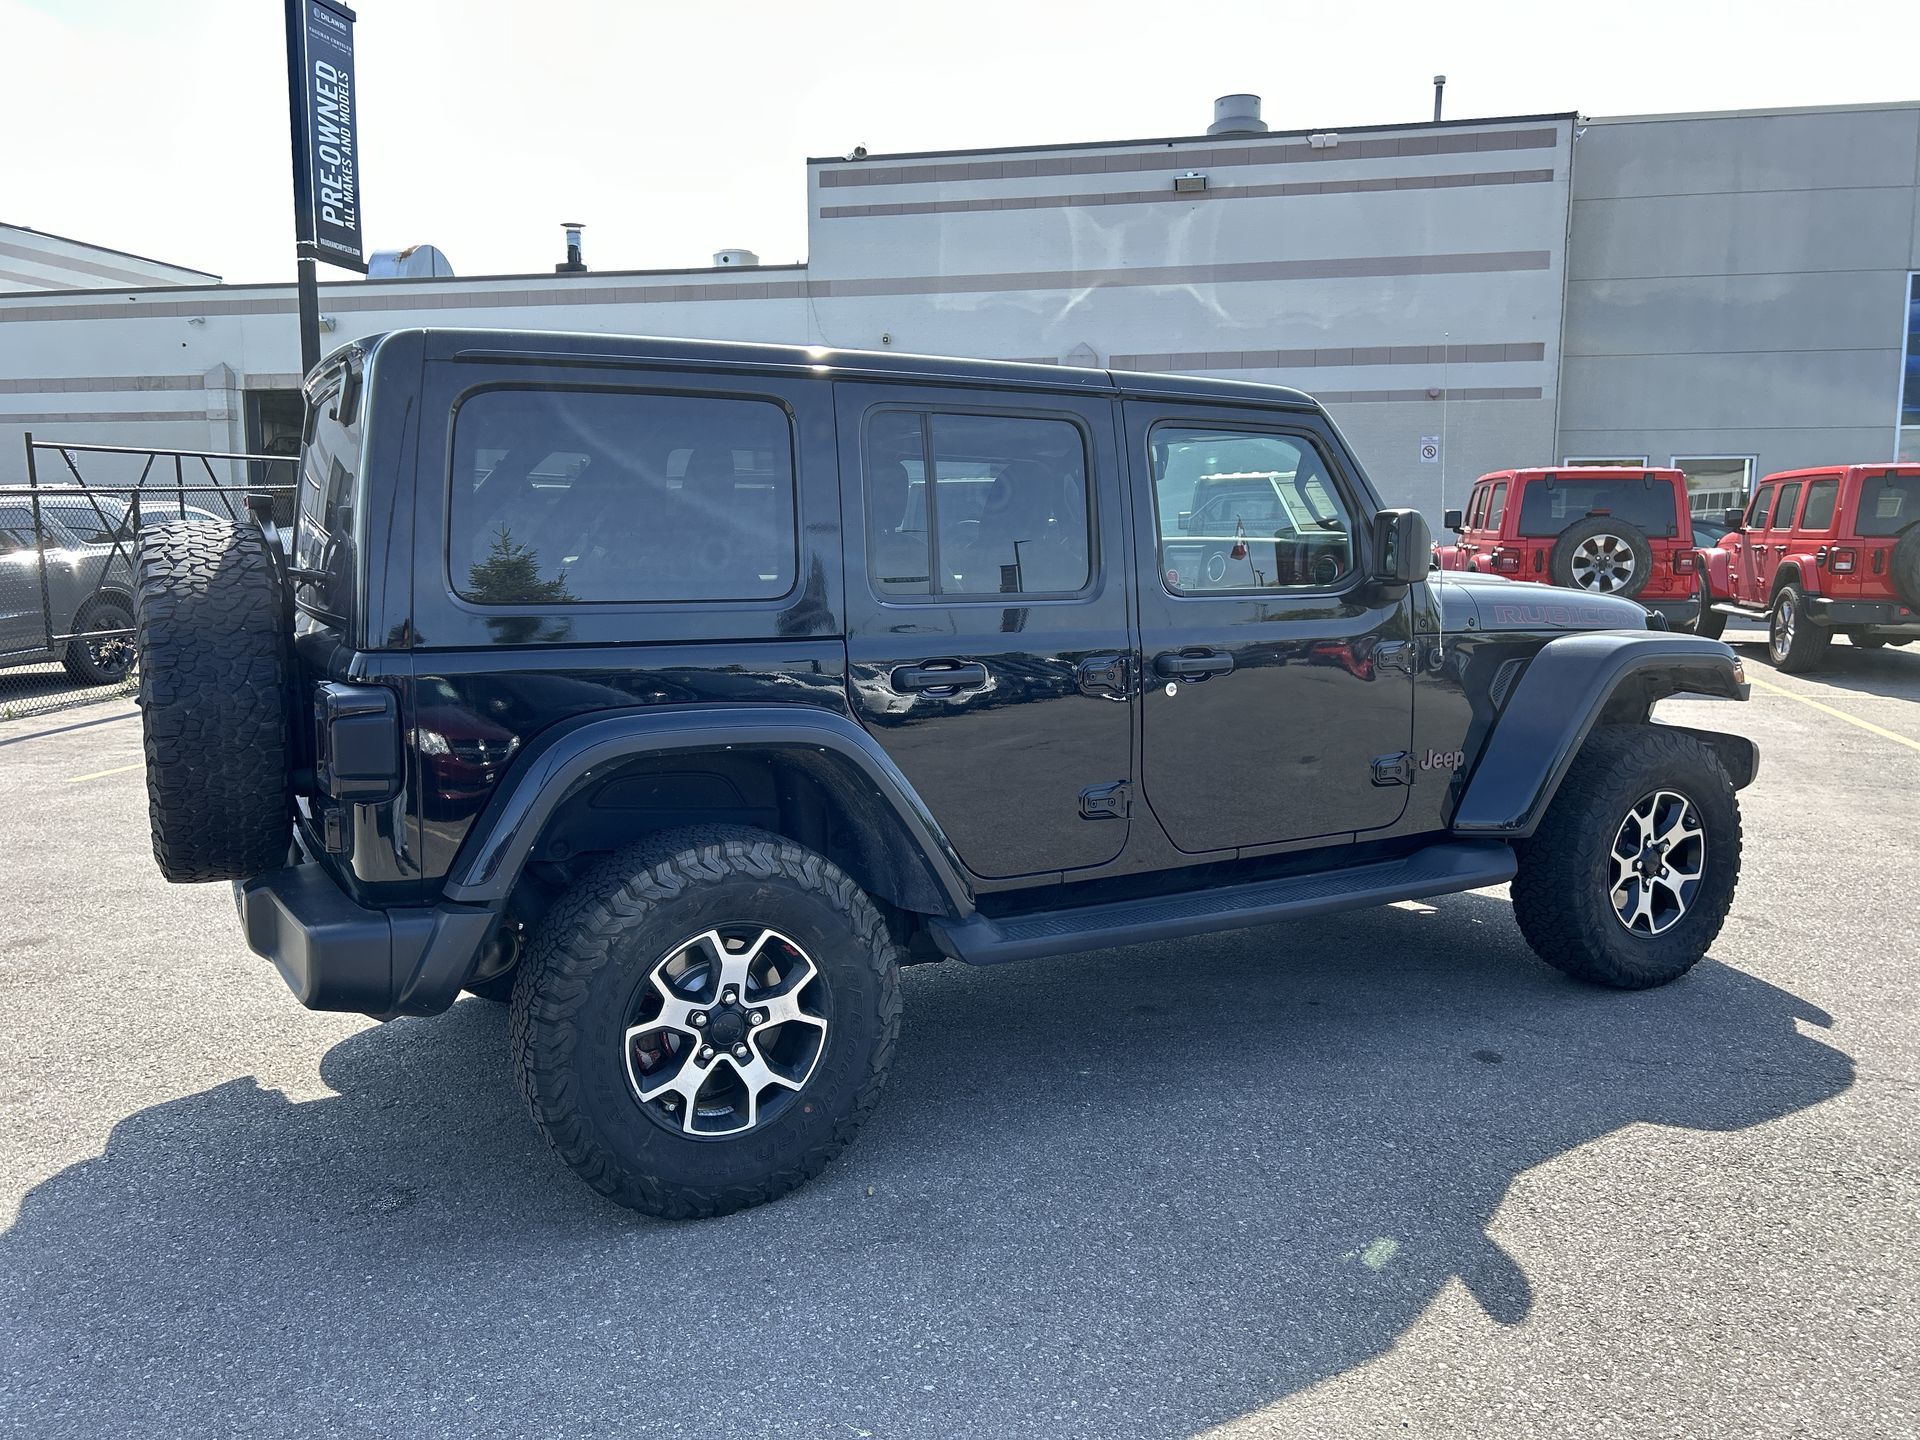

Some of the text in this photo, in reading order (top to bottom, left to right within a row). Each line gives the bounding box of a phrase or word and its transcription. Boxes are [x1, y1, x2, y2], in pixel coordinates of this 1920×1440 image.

[315, 60, 345, 228] PRE-OWNED
[337, 70, 355, 231] ALL MAKES AND MODELS
[1495, 605, 1639, 624] RUBICON
[1420, 748, 1465, 771] Jeep
